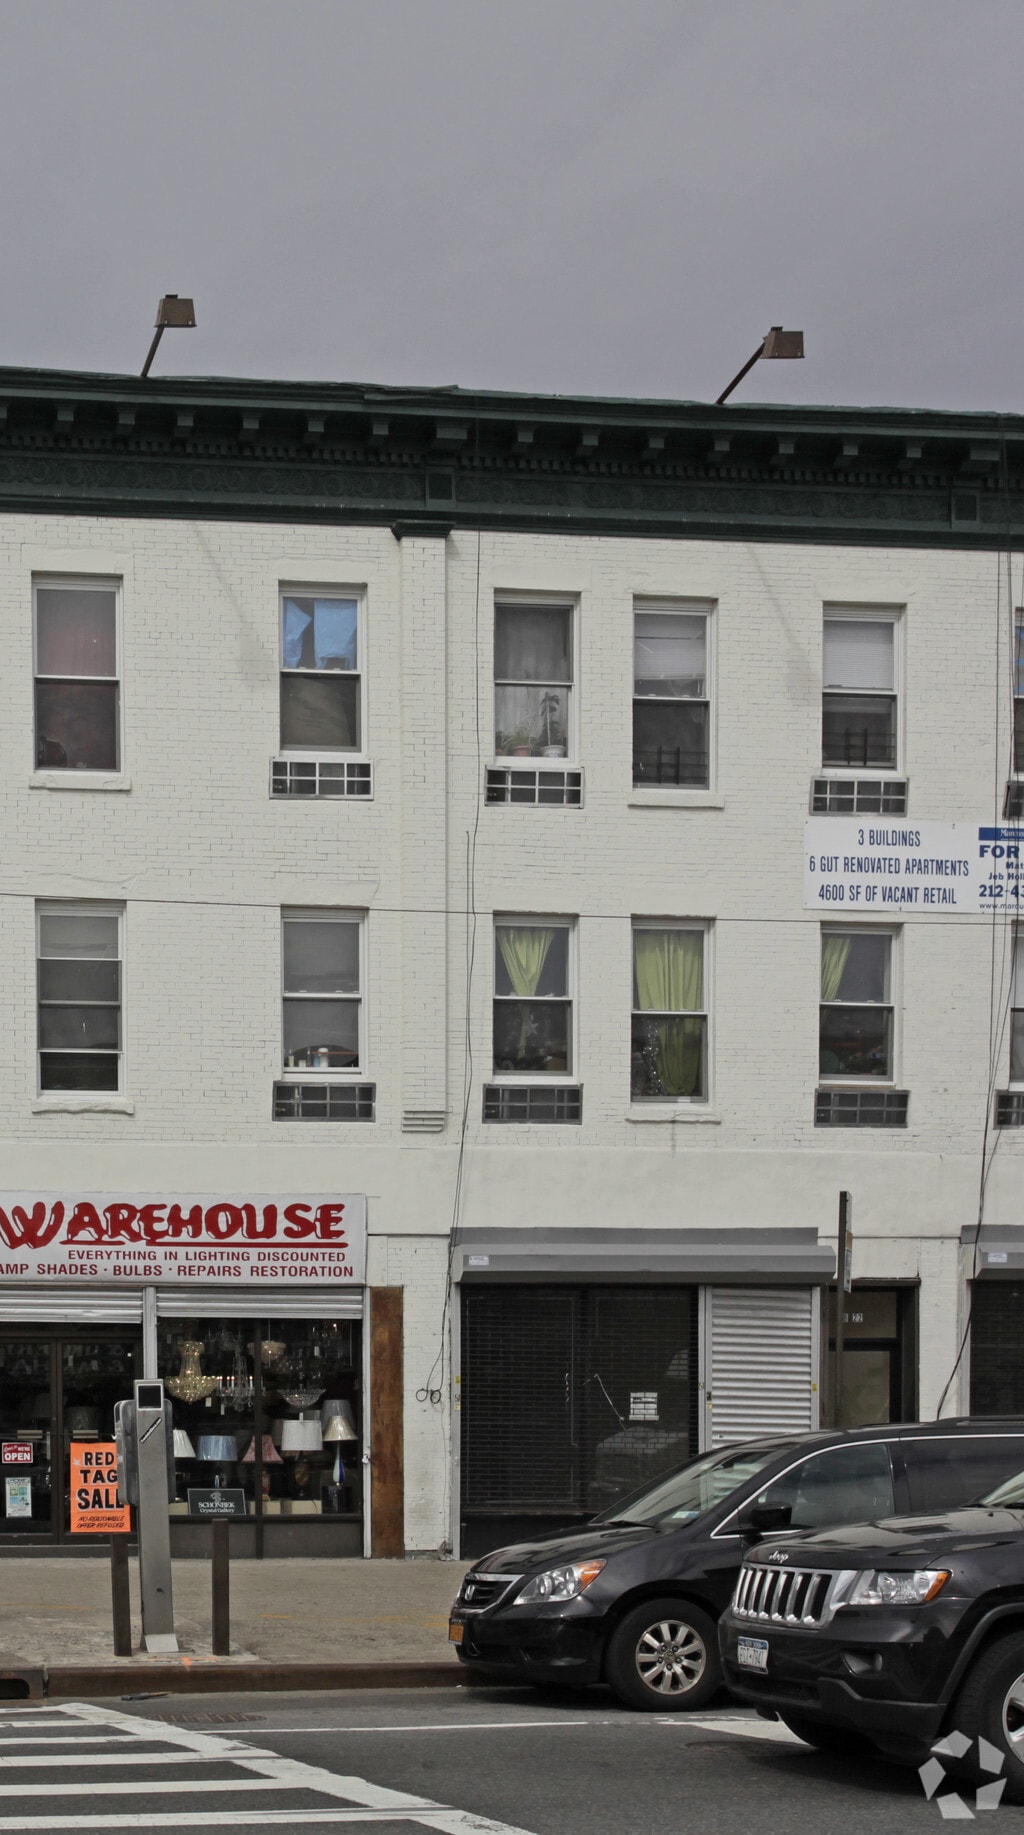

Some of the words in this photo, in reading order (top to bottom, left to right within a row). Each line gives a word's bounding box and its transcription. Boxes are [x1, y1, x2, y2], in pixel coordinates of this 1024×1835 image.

[858, 829, 864, 846] 3
[869, 830, 920, 847] BUILDINGS
[979, 844, 1020, 858] FOR
[810, 856, 816, 872] 6
[820, 856, 840, 872] GUT
[844, 857, 900, 874] RENOVATED
[904, 859, 969, 876] APARTMENTS
[988, 872, 1004, 880] Jeb
[818, 884, 844, 901] 4600
[849, 884, 861, 902] SF
[866, 885, 878, 902] OF
[882, 886, 920, 904] VACANT
[924, 887, 957, 904] RETAIL
[68, 1250, 156, 1260] EVERYTHING
[164, 1250, 177, 1261] IN
[186, 1251, 250, 1262] LIGHTING
[258, 1252, 346, 1262] DISCOUNTED
[37, 1263, 98, 1276] SHADES
[113, 1264, 162, 1276] BULBS
[177, 1265, 242, 1277] REPAIRS
[250, 1266, 354, 1278] RESTORATION
[84, 1452, 114, 1466] RED
[80, 1470, 118, 1484] TAG
